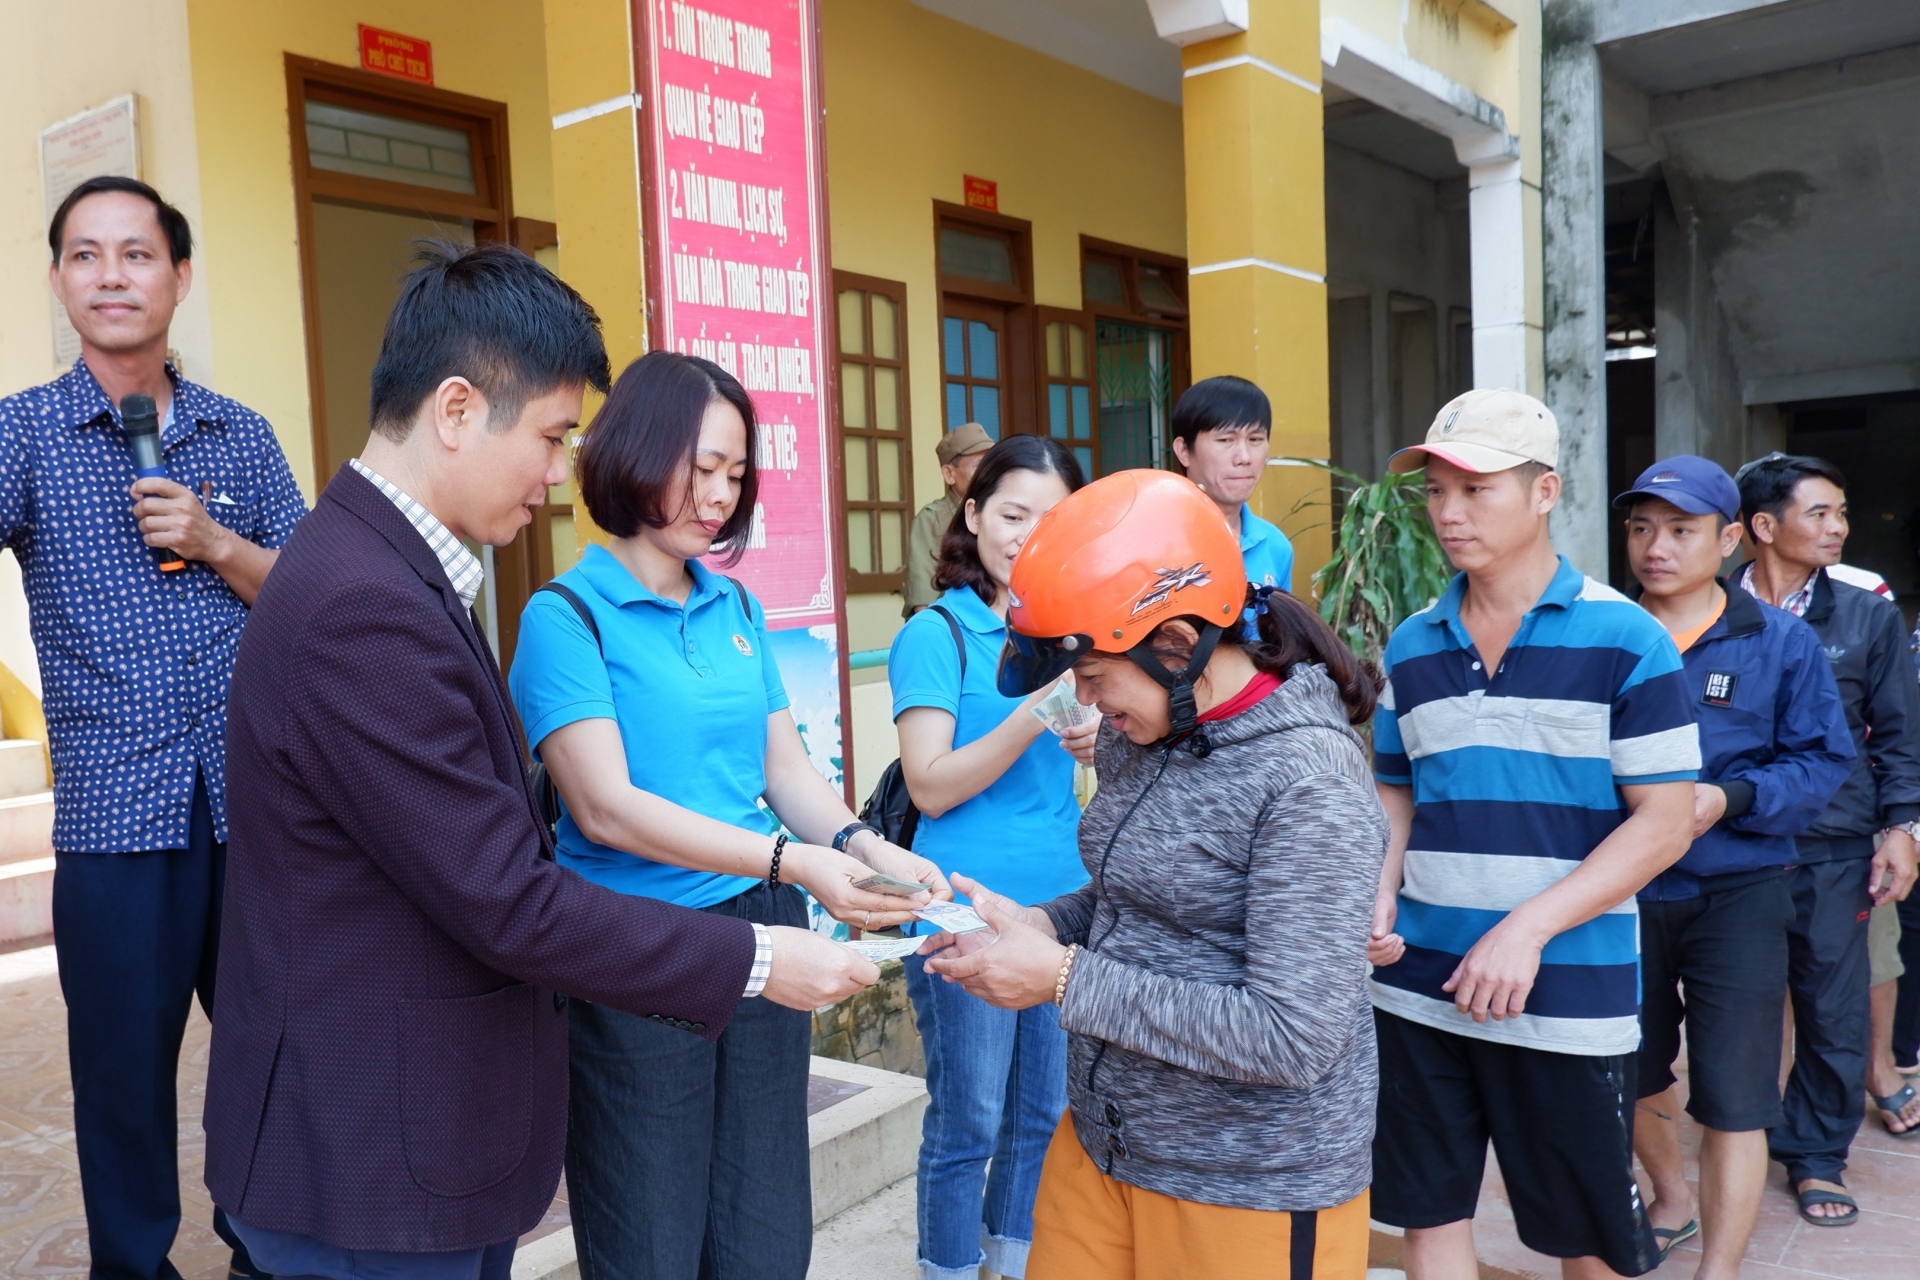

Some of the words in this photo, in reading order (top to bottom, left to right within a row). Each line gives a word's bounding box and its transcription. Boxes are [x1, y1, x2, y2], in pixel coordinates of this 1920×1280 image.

[659, 0, 672, 50] 1.
[697, 8, 734, 75] TRỌNG
[735, 21, 772, 78] TRONG
[664, 82, 697, 140] QUAN
[697, 83, 713, 154] HỆ
[713, 96, 740, 150] GIAO
[740, 91, 765, 155] TIẾP
[669, 168, 683, 219] 2.
[682, 162, 708, 224] VĂN
[707, 176, 743, 236] MINH,
[741, 183, 768, 243] LỊCH
[767, 186, 788, 248] SỰ,
[673, 243, 700, 305] VĂN
[699, 248, 725, 308] HÓA
[724, 260, 762, 312] TRONG
[762, 265, 787, 316] GIAO
[786, 256, 810, 318] TIẾP
[741, 333, 776, 392] TRÁCH
[776, 338, 815, 404] NHIỆM,
[773, 414, 798, 481] VIỆC
